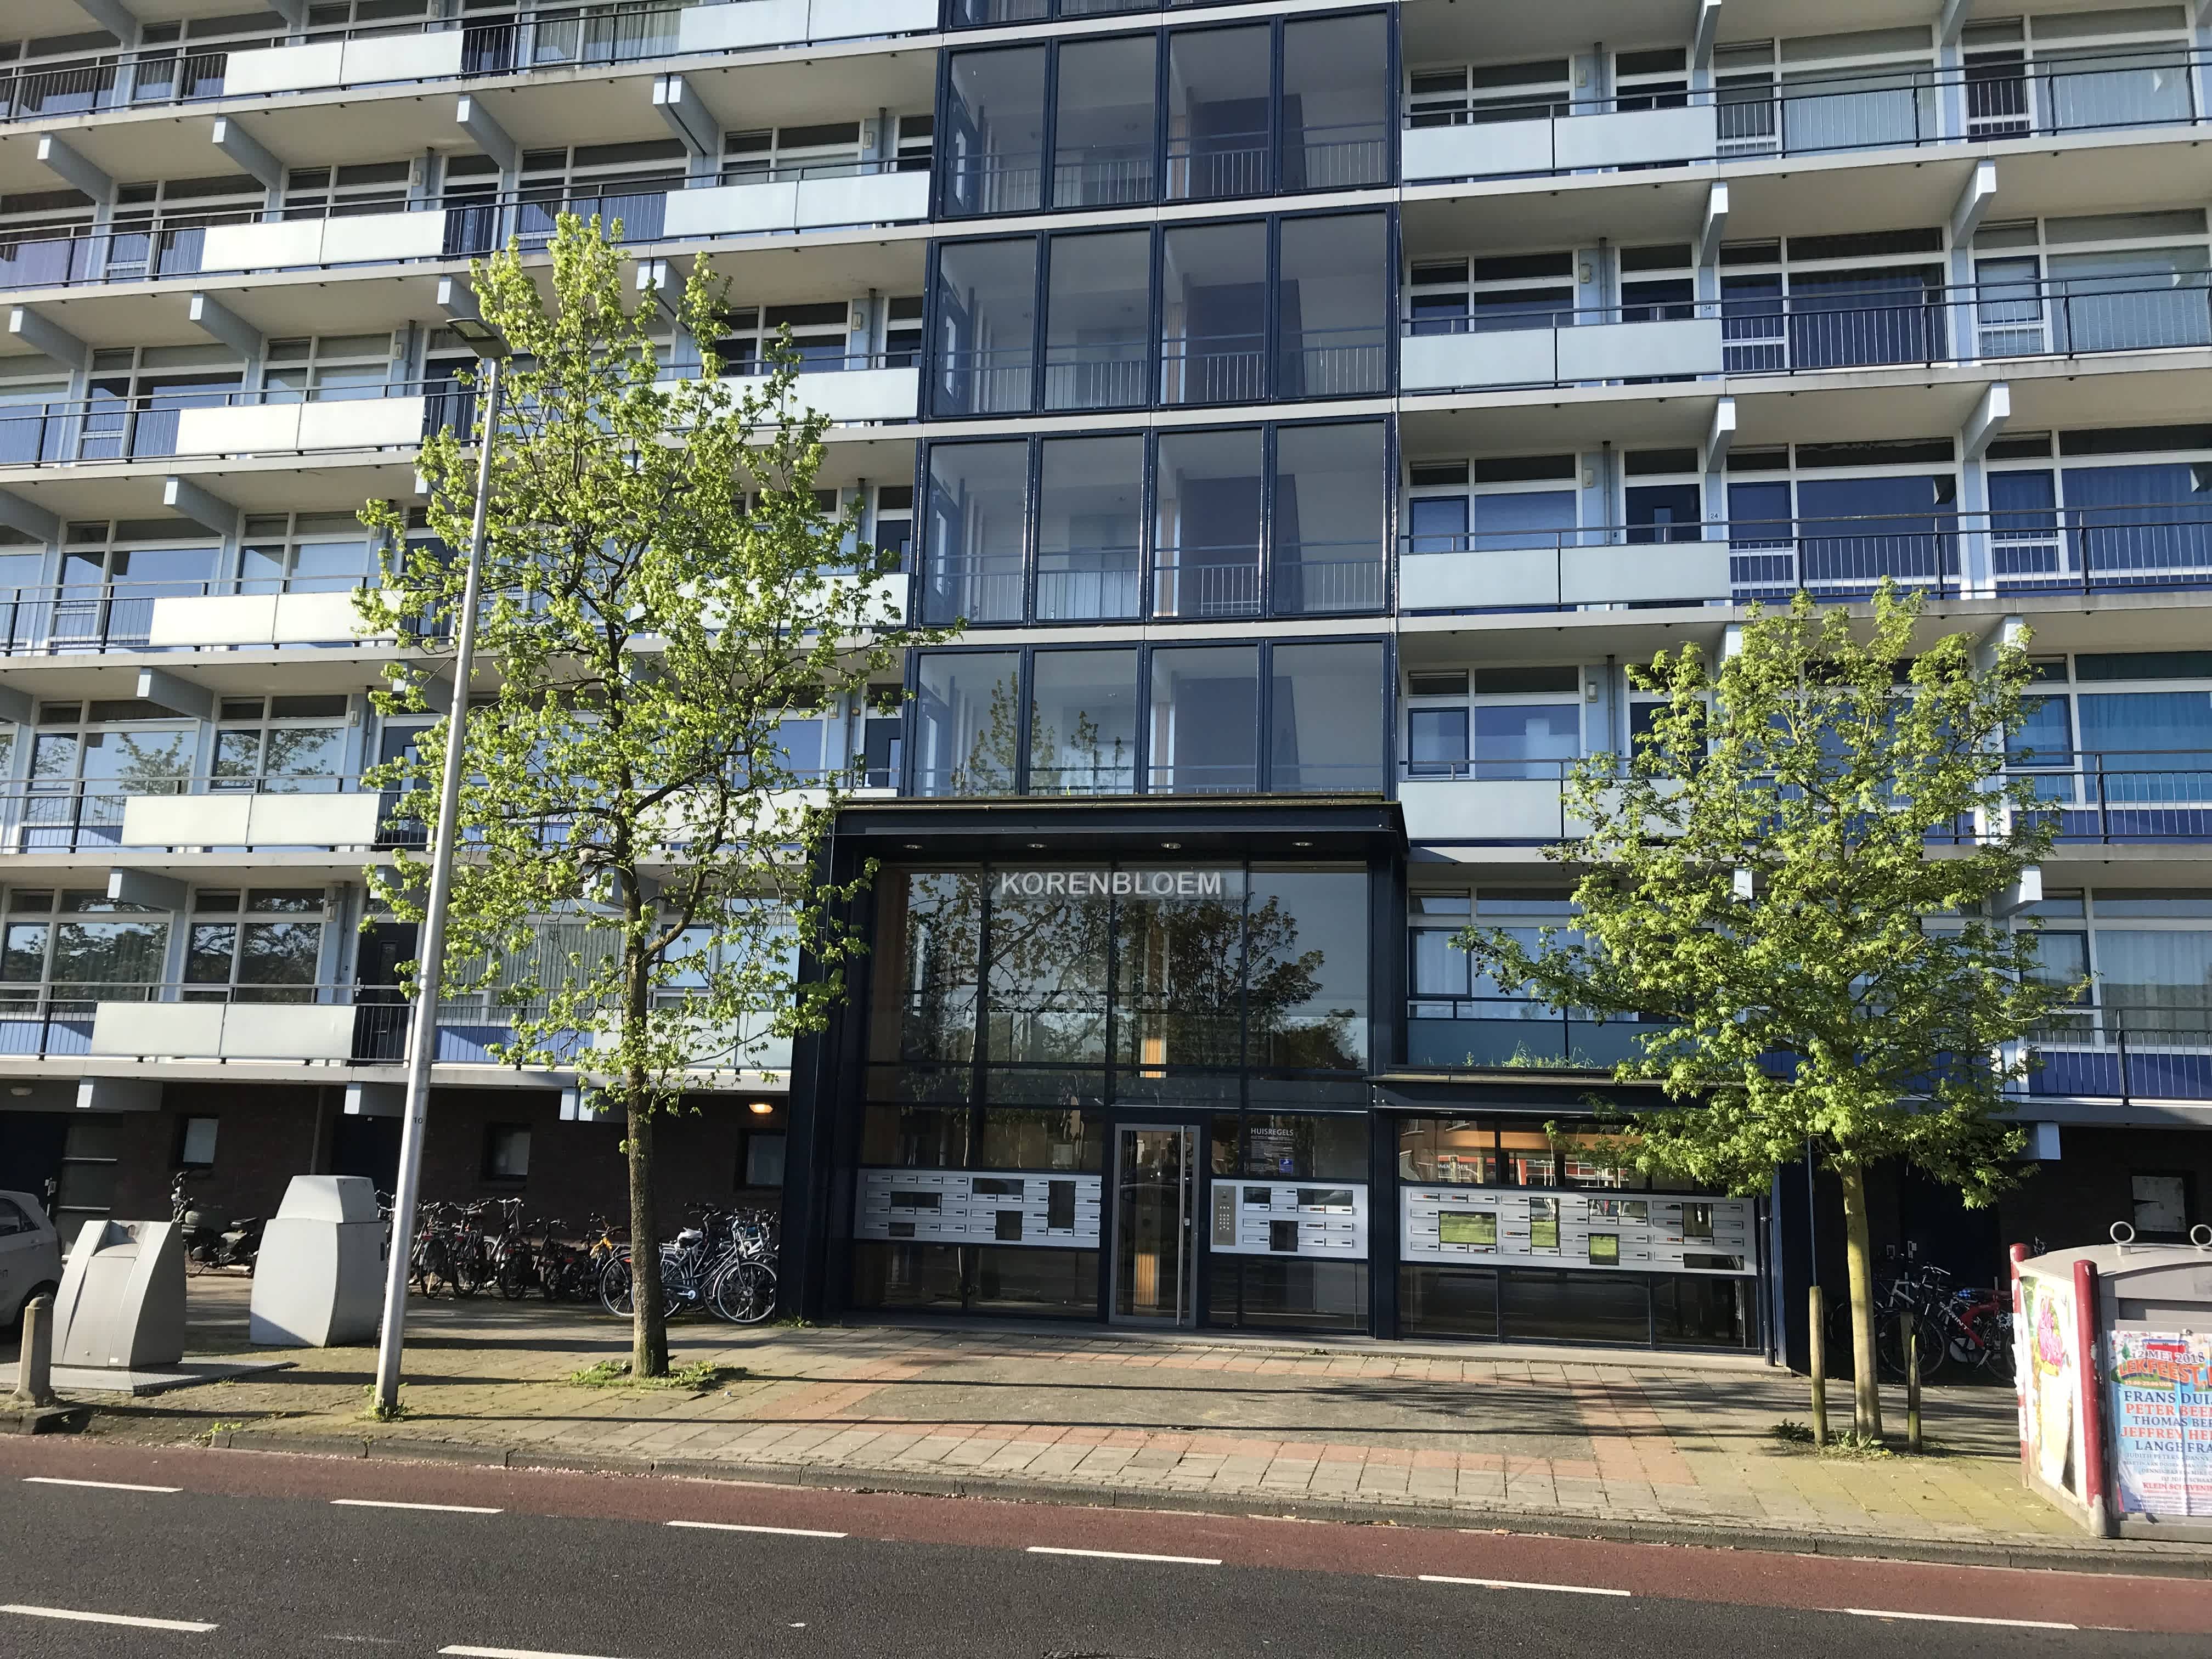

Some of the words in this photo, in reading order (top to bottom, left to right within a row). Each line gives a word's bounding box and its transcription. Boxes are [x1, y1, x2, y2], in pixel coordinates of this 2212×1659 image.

[1001, 872, 1221, 895] KORENBLOEM
[1251, 1127, 1294, 1136] HUISREGELS
[2149, 1350, 2172, 1361] MEI
[2176, 1352, 2205, 1363] 2018
[2124, 1391, 2176, 1403] FRANS
[2181, 1393, 2212, 1405] DUI
[2125, 1403, 2175, 1415] PETER
[2132, 1415, 2188, 1426] THOMAS
[2120, 1426, 2182, 1439] JEFFREY
[2135, 1440, 2182, 1452] LANGE
